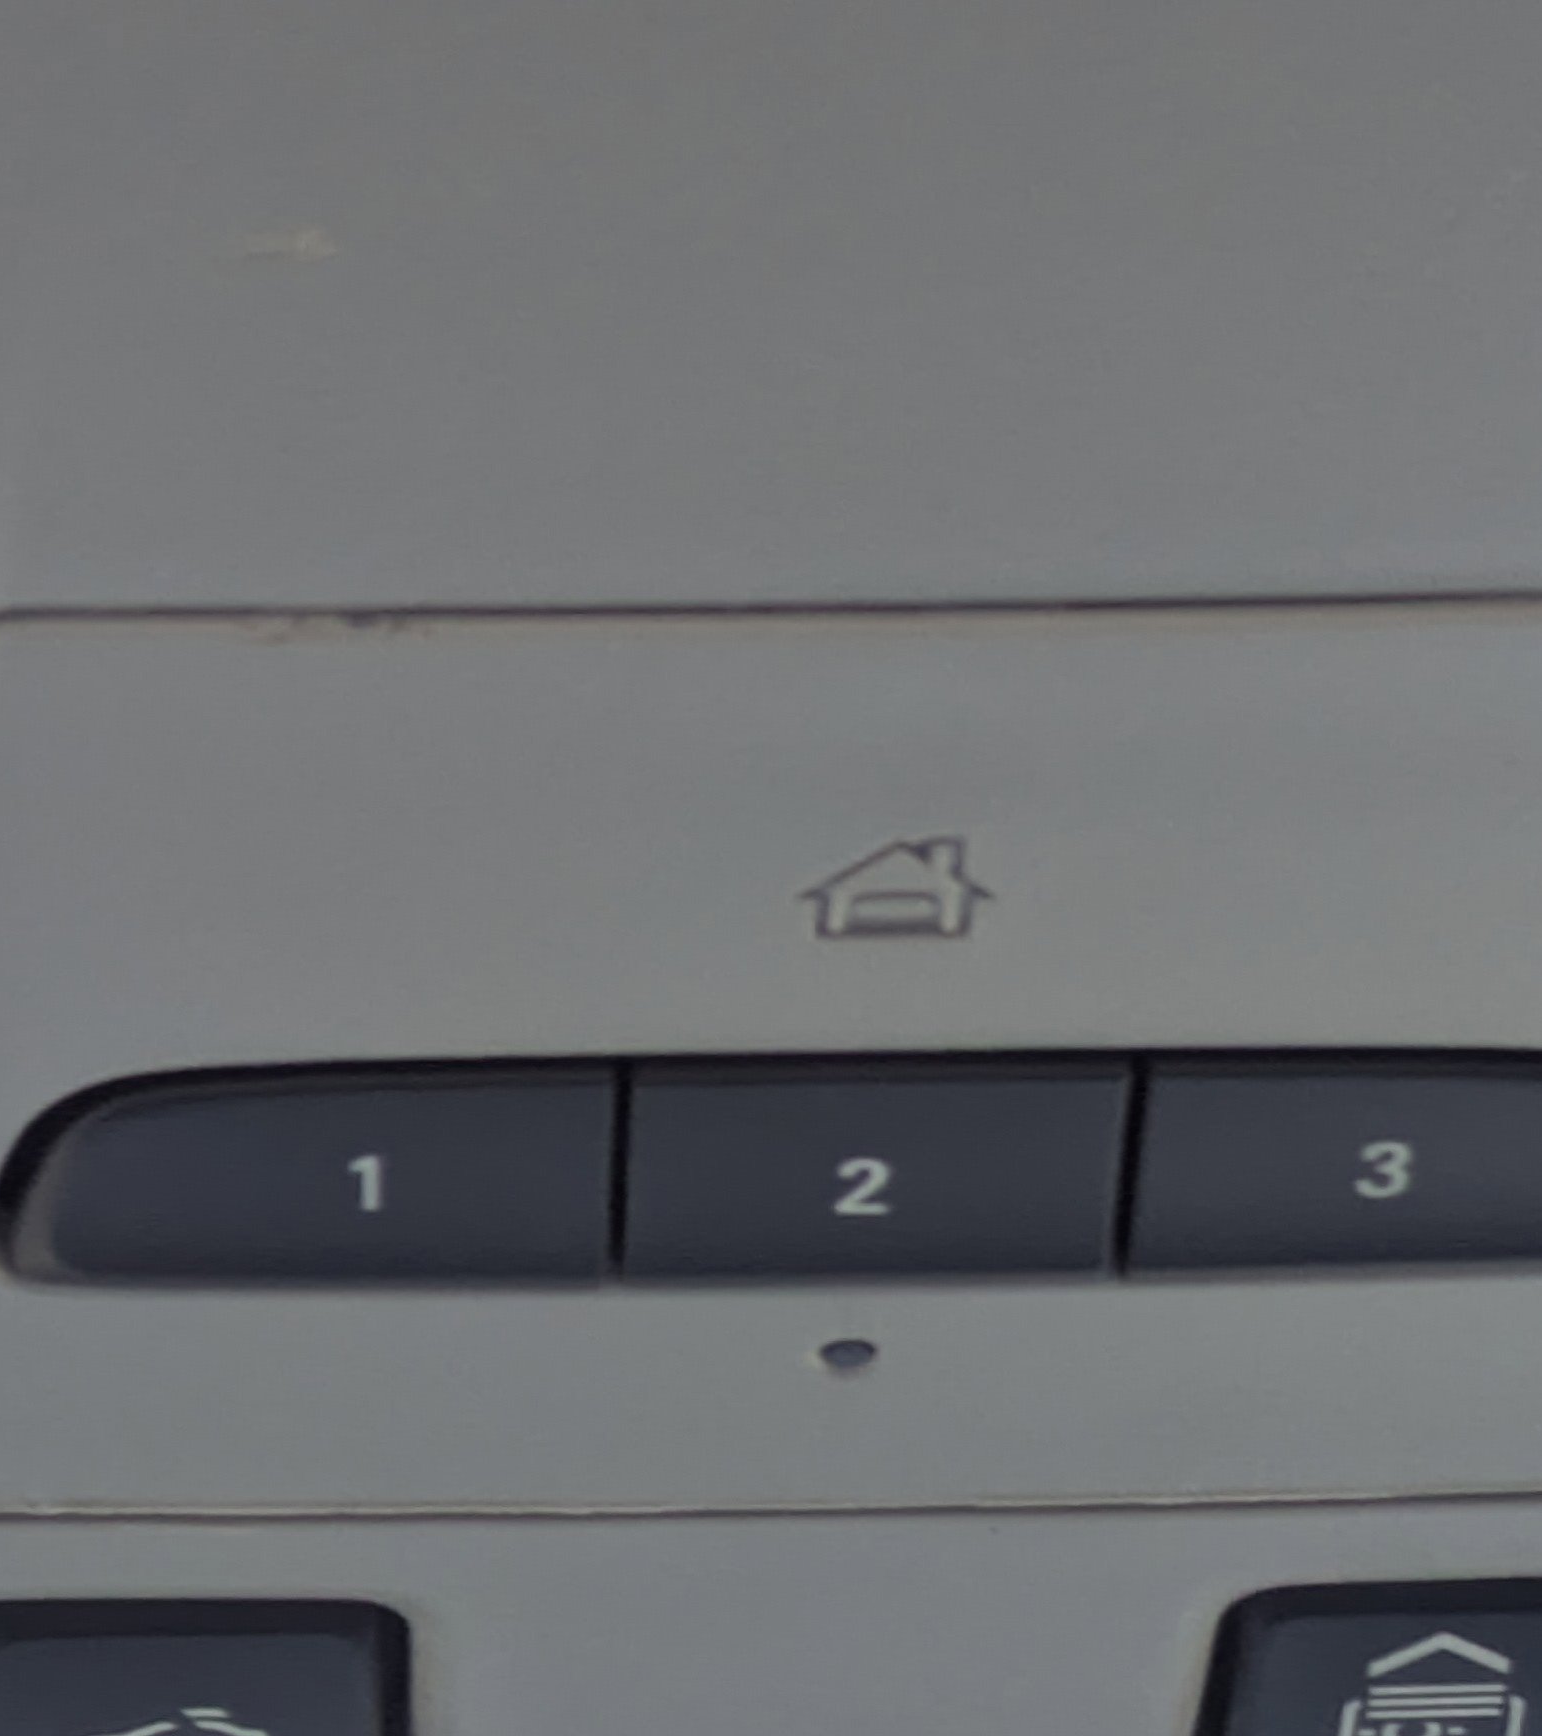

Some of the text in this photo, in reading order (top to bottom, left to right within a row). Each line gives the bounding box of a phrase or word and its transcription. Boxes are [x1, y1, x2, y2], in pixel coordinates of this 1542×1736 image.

[346, 1153, 383, 1213] 1
[832, 1156, 893, 1217] 2
[1353, 1139, 1414, 1200] 3
